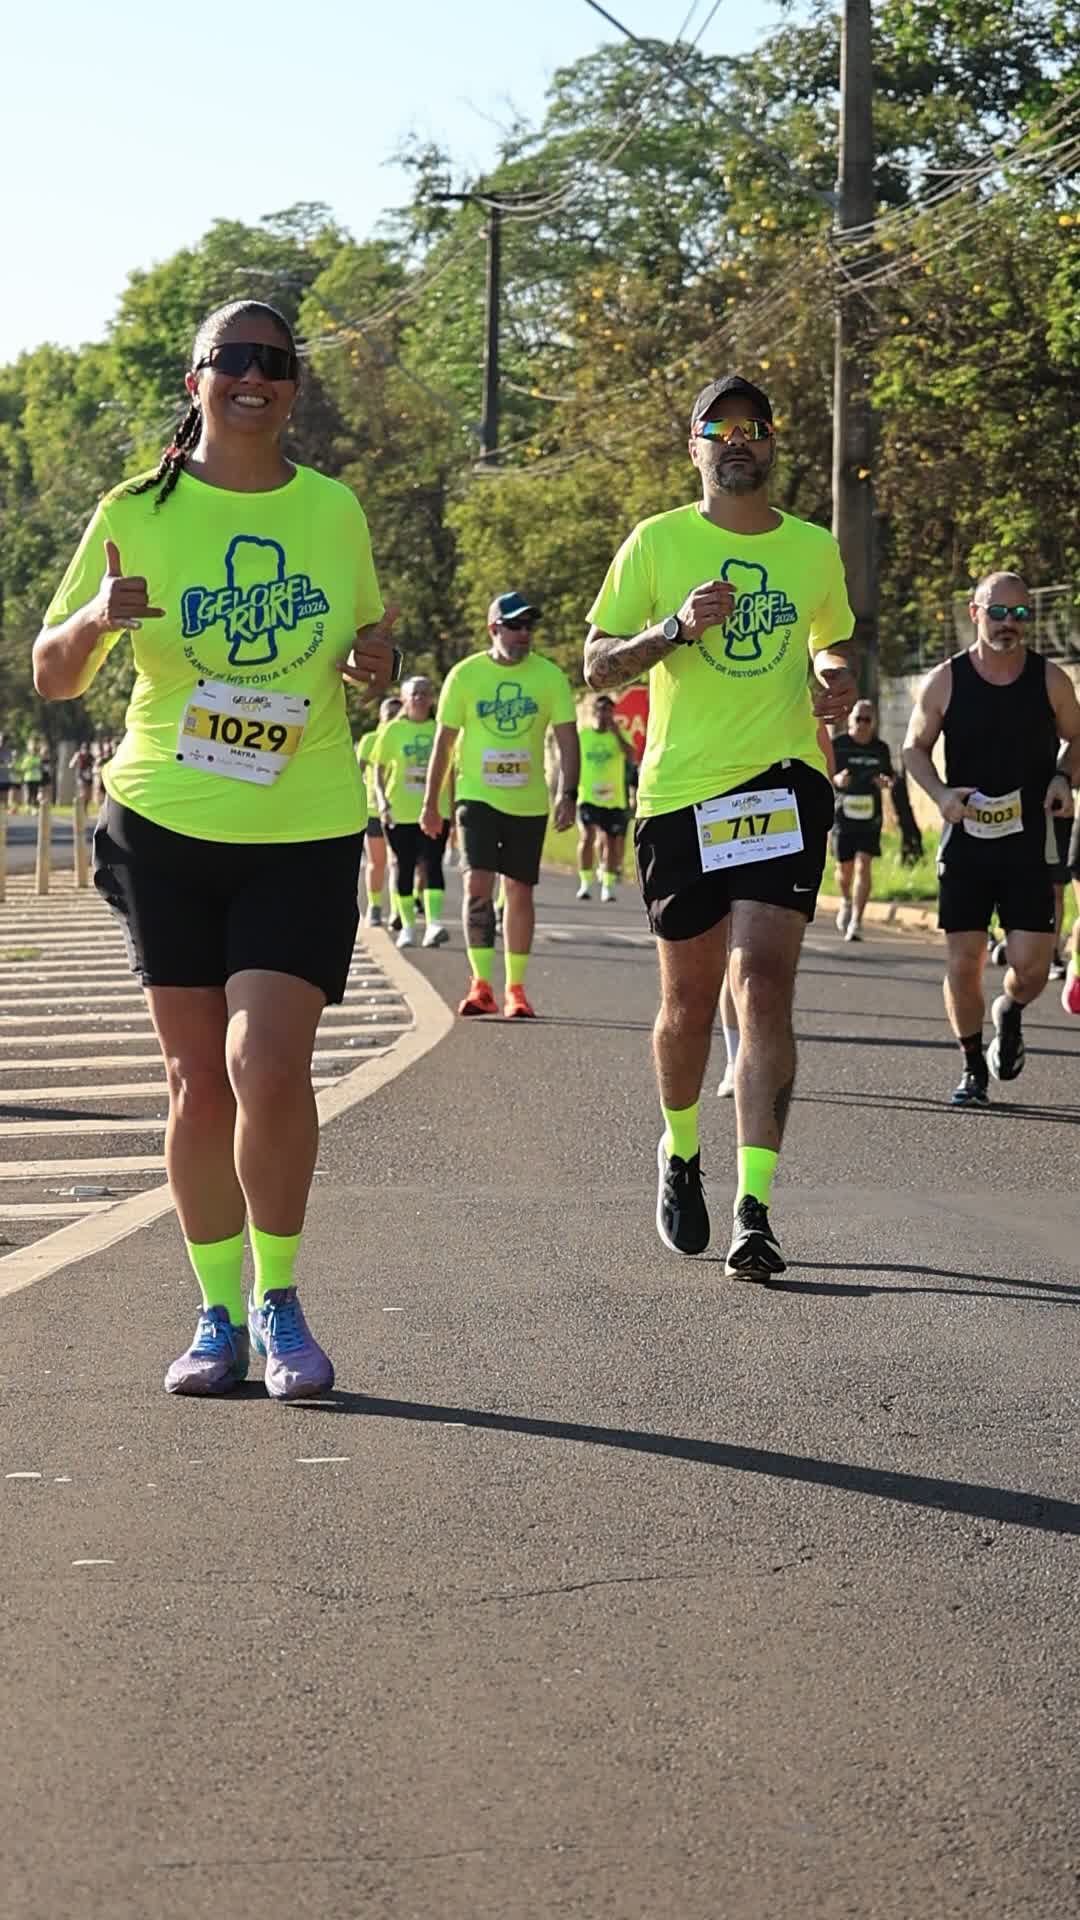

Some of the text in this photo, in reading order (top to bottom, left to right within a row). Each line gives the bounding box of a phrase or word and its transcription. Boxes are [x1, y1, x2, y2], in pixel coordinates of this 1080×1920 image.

[197, 577, 321, 621] GELOBEL
[227, 598, 326, 638] RUN 2026
[208, 714, 288, 753] 1029
[496, 762, 521, 774] 621
[727, 814, 771, 840] 717
[976, 807, 1013, 824] 1003
